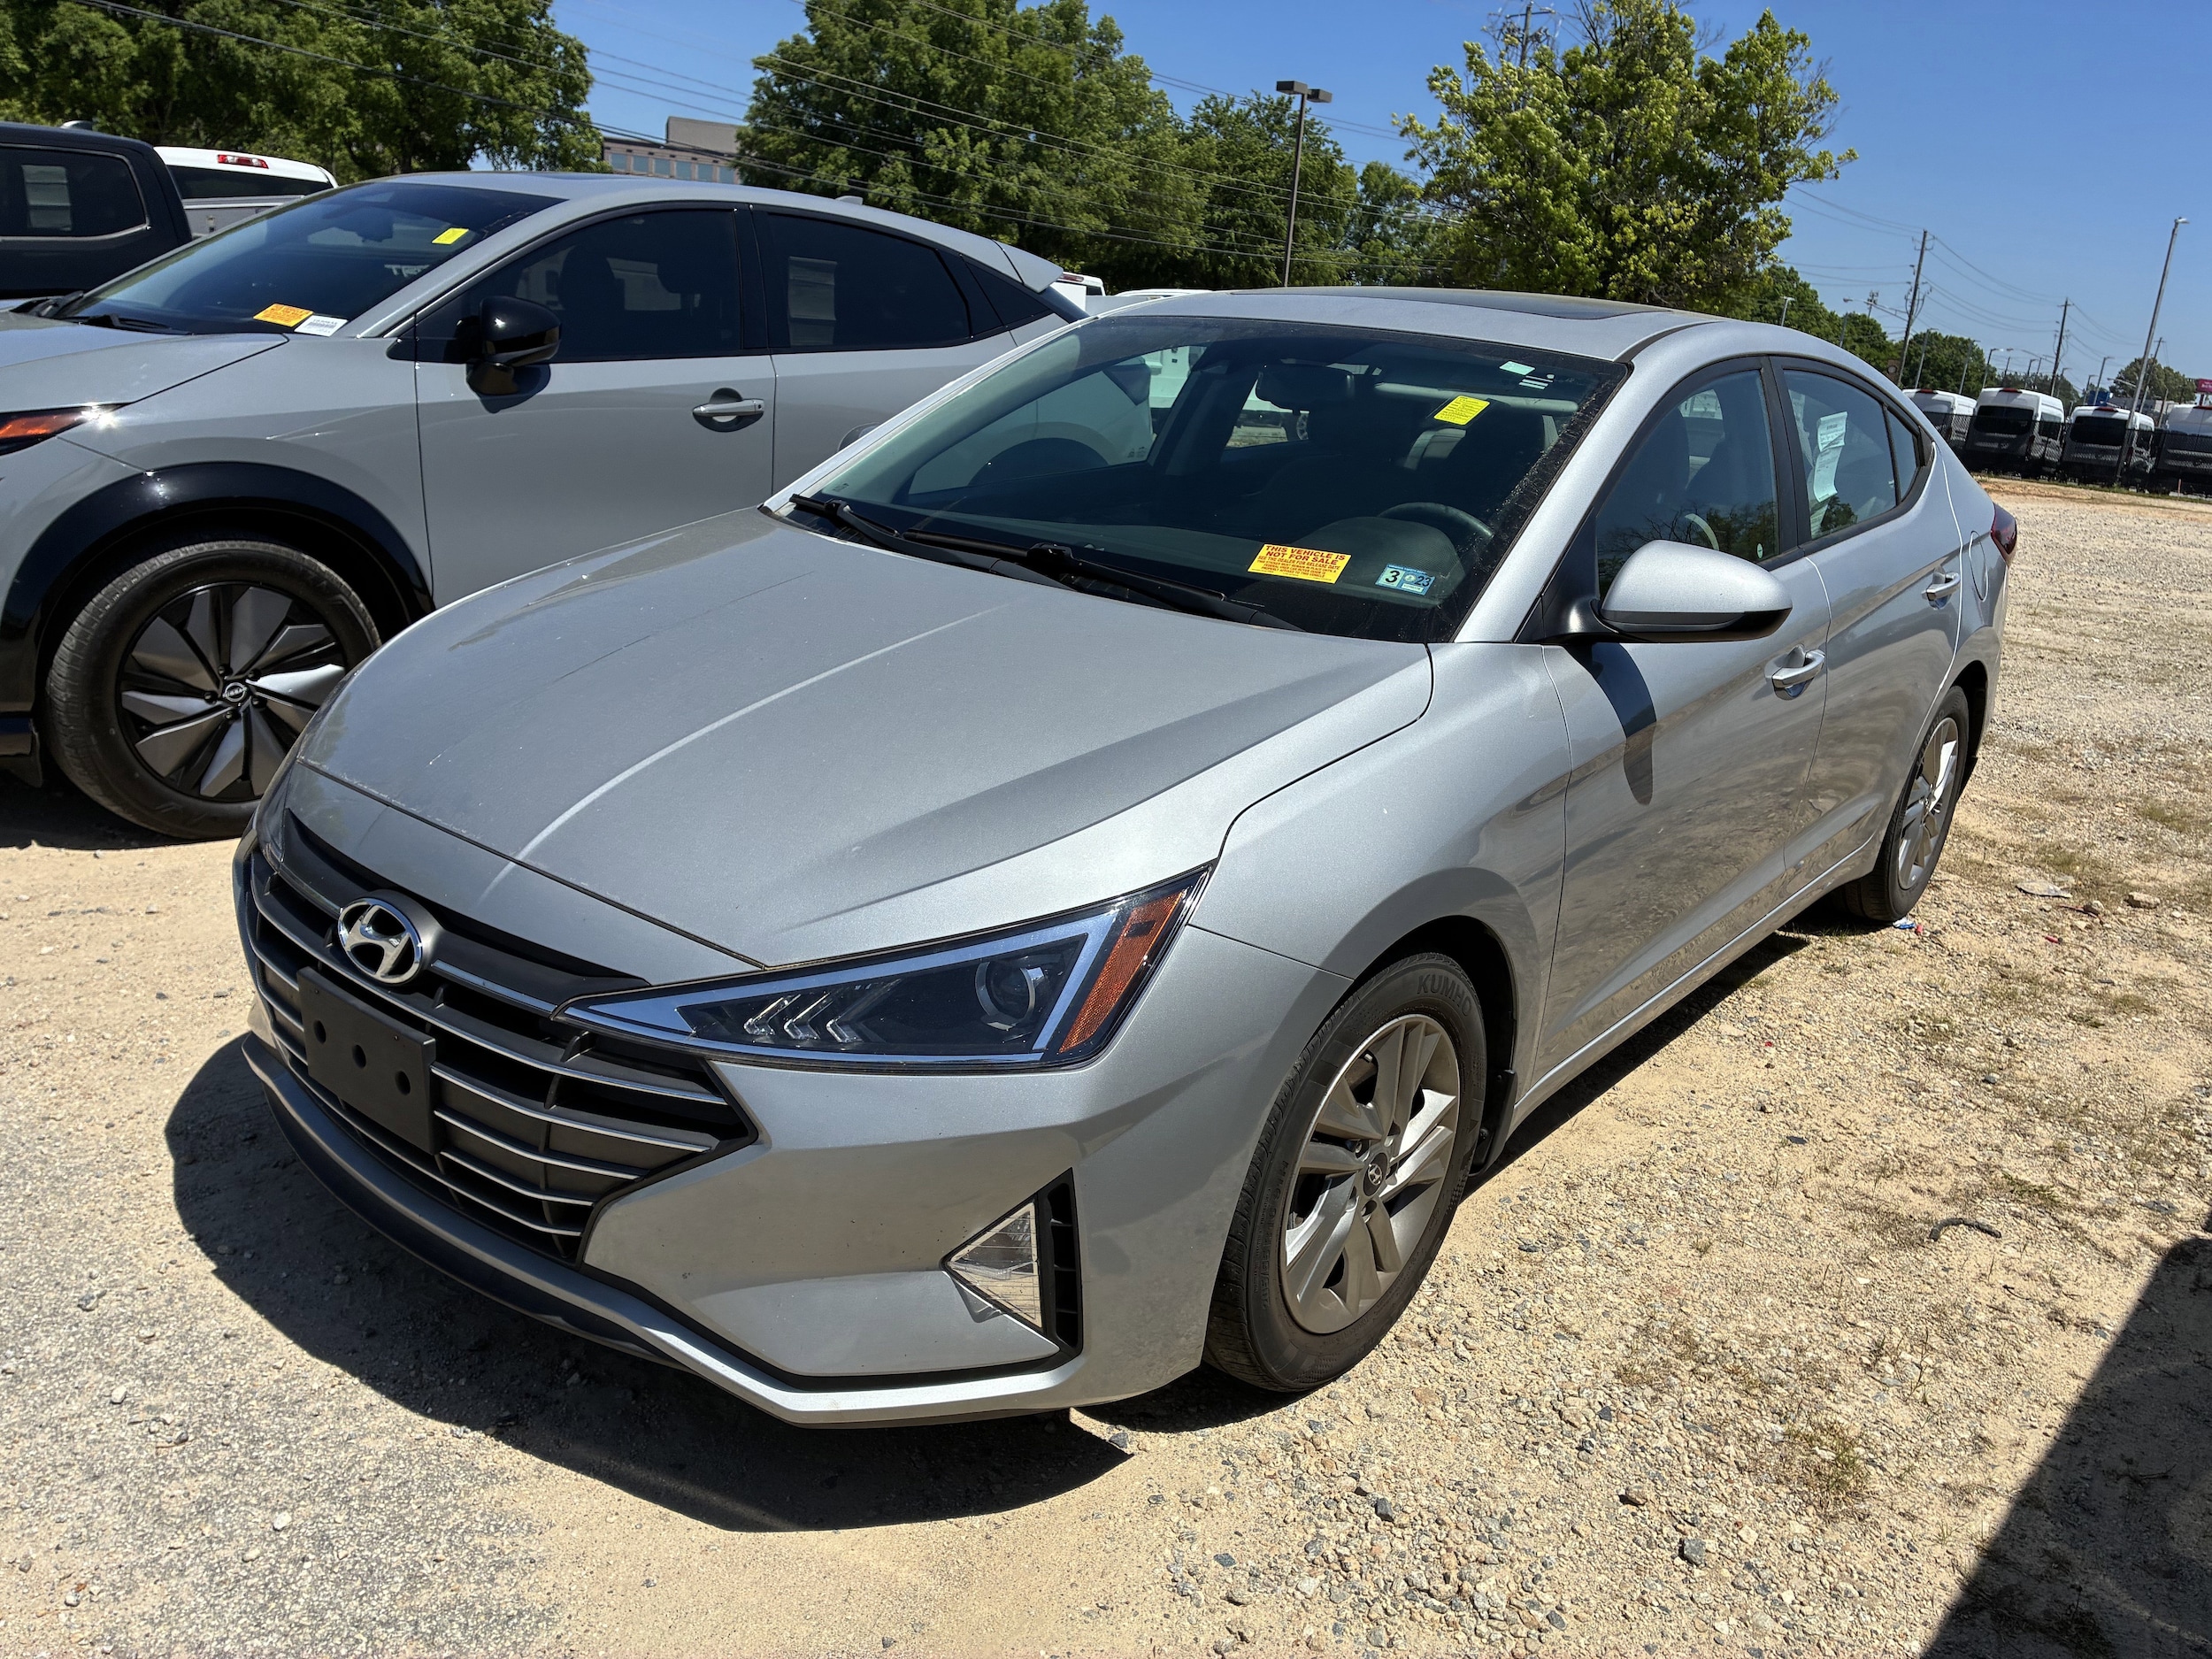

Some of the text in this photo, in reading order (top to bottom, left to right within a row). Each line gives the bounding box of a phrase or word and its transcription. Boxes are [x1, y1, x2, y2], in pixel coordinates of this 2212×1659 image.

[1290, 549, 1333, 558] VEHICLE
[1385, 570, 1401, 583] 3
[1415, 575, 1432, 587] 23
[1417, 974, 1472, 1017] KUMHO
